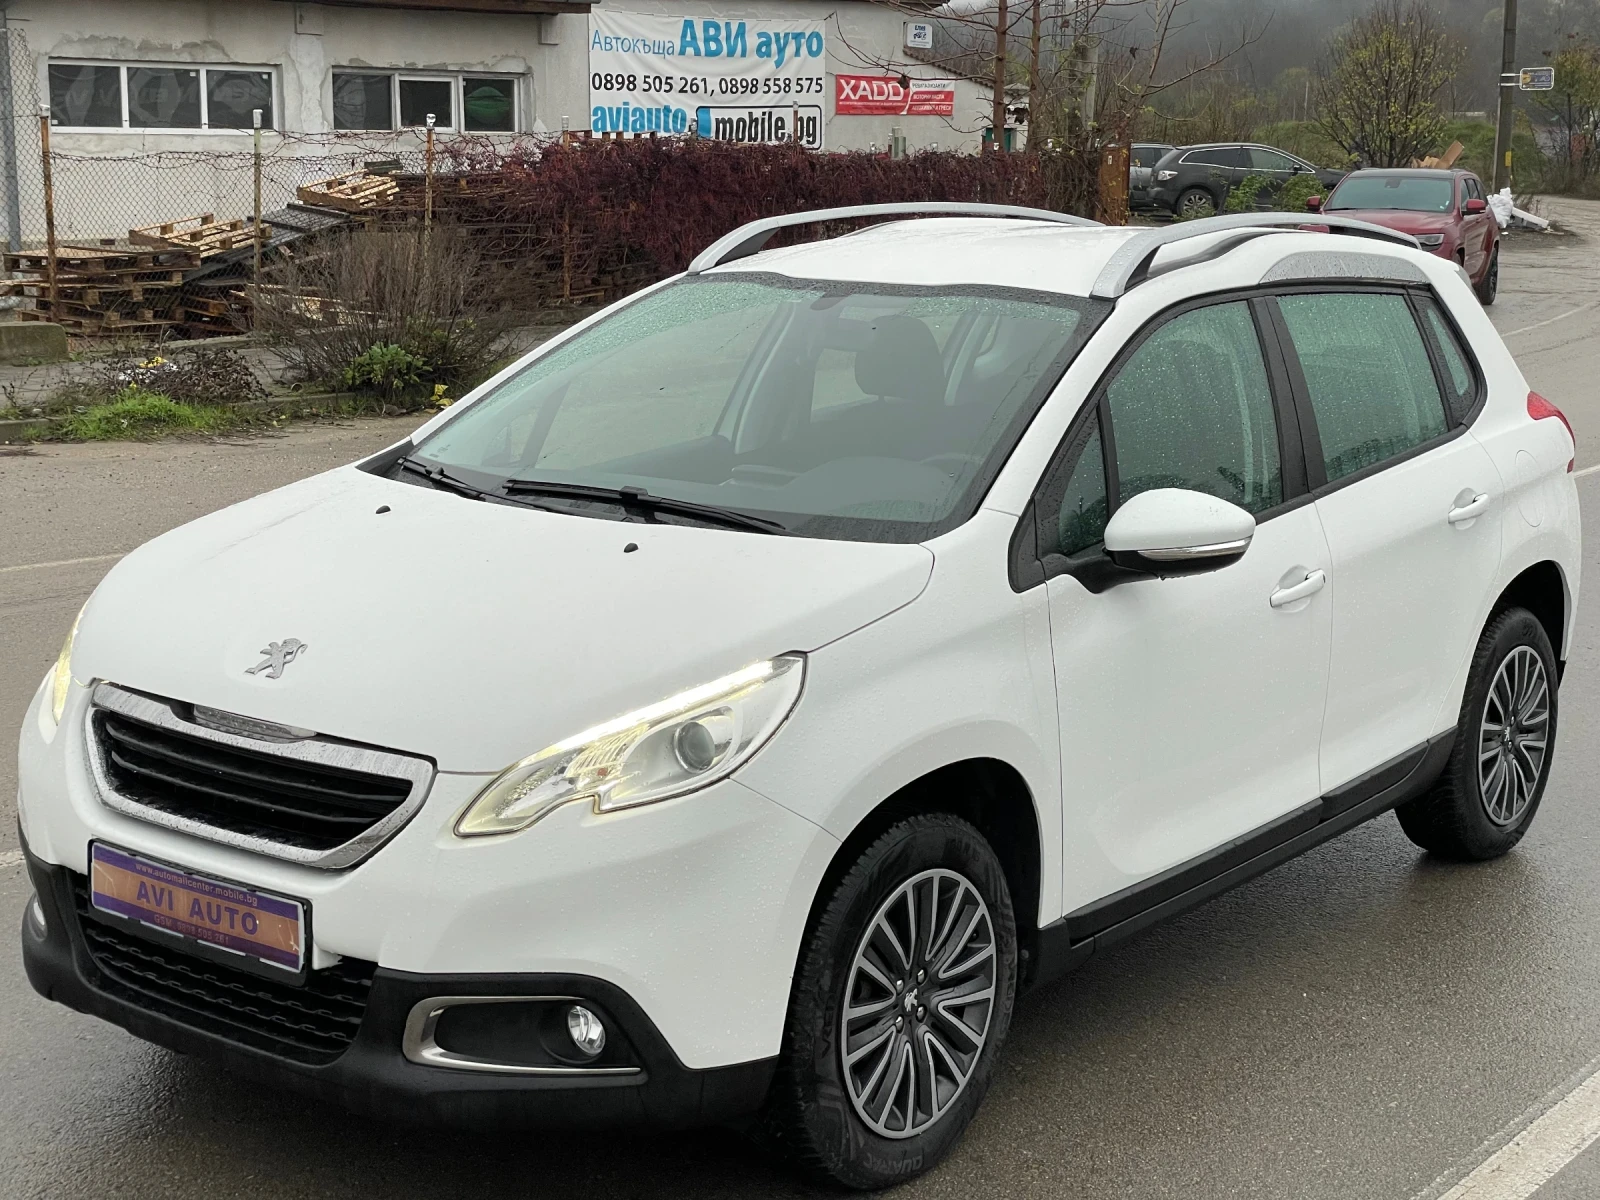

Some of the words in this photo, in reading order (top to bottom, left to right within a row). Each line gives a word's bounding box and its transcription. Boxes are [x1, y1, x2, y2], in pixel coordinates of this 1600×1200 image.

[591, 30, 675, 59] Автокъща
[678, 19, 748, 58] АВИ
[755, 31, 824, 69] ауто
[591, 72, 637, 92] 0898
[642, 75, 674, 93] 505
[678, 77, 715, 97] 261,
[719, 77, 759, 95] 0898
[763, 78, 792, 95] 558
[795, 77, 824, 94] 575
[591, 101, 687, 133] aviauto
[136, 880, 174, 911] AVI
[189, 898, 258, 935] AUTO
